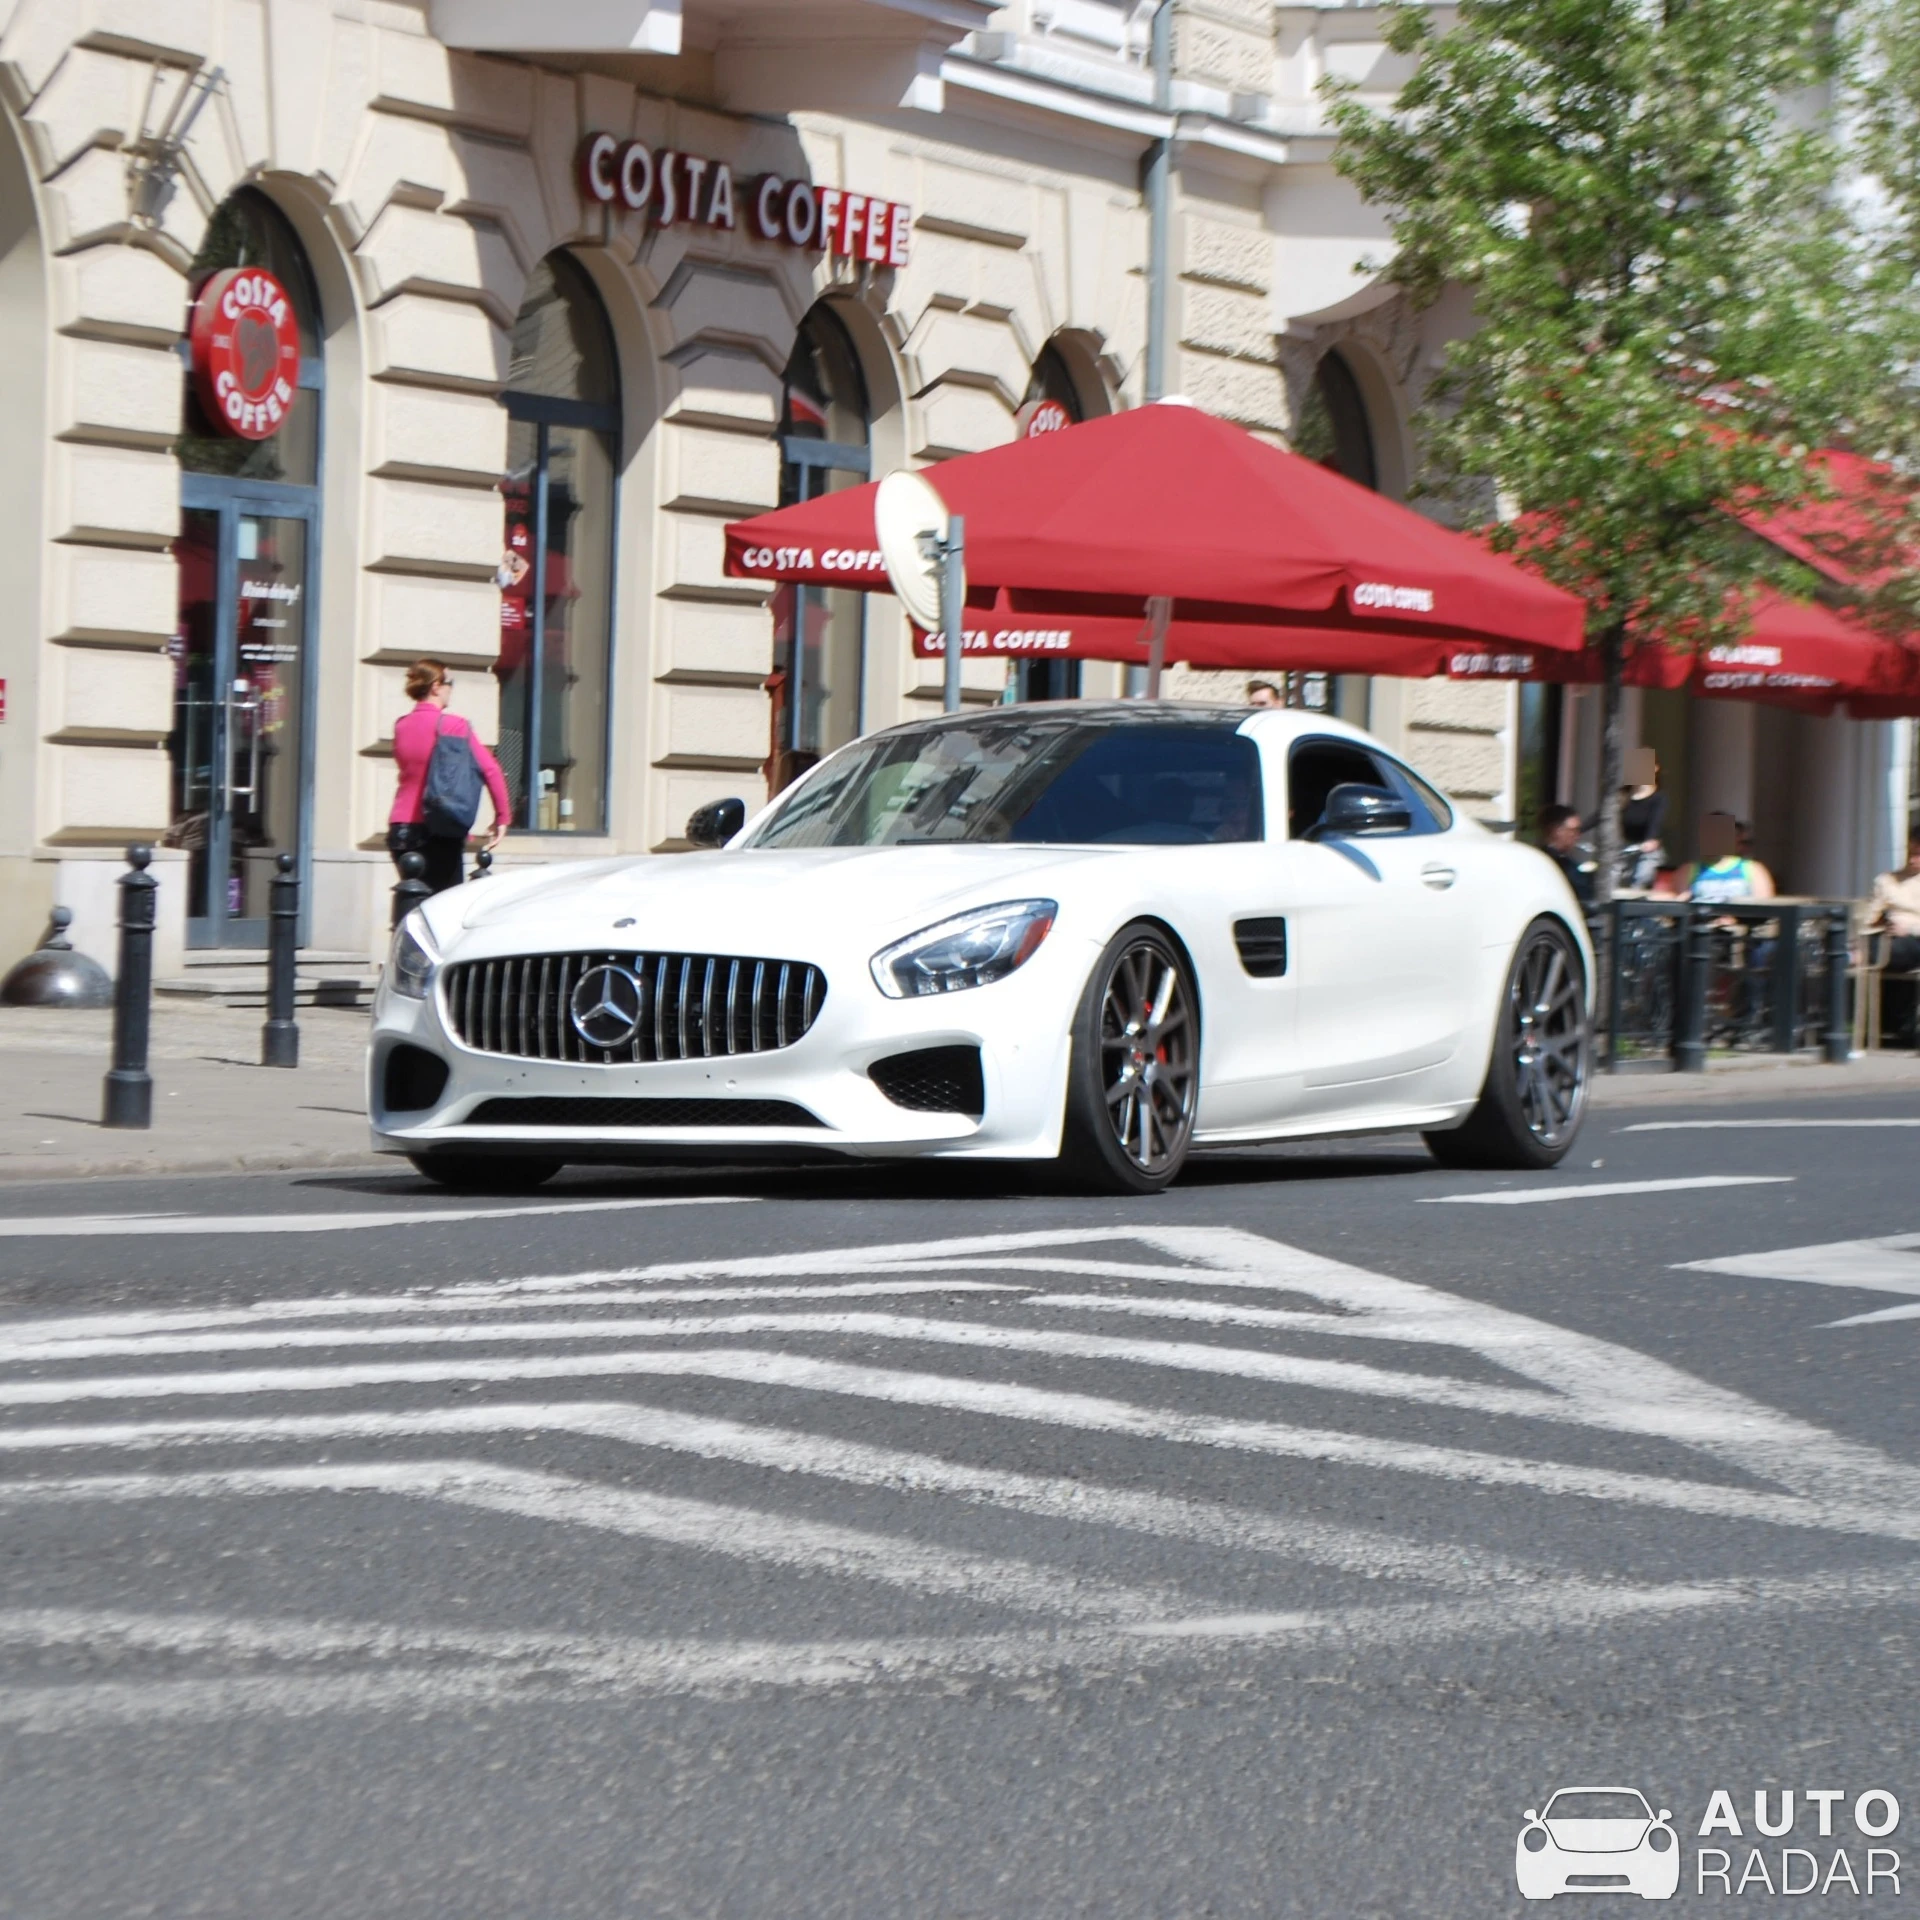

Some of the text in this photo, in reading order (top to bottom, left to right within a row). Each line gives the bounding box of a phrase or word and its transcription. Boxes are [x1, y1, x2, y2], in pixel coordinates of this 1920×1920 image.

[585, 133, 911, 265] COSTA COFFEE
[222, 275, 287, 328] COSTA
[216, 370, 293, 432] COFFEE
[1029, 406, 1070, 438] COST
[742, 547, 888, 572] COSTA COFF
[924, 630, 1072, 650] COTA COFFEE
